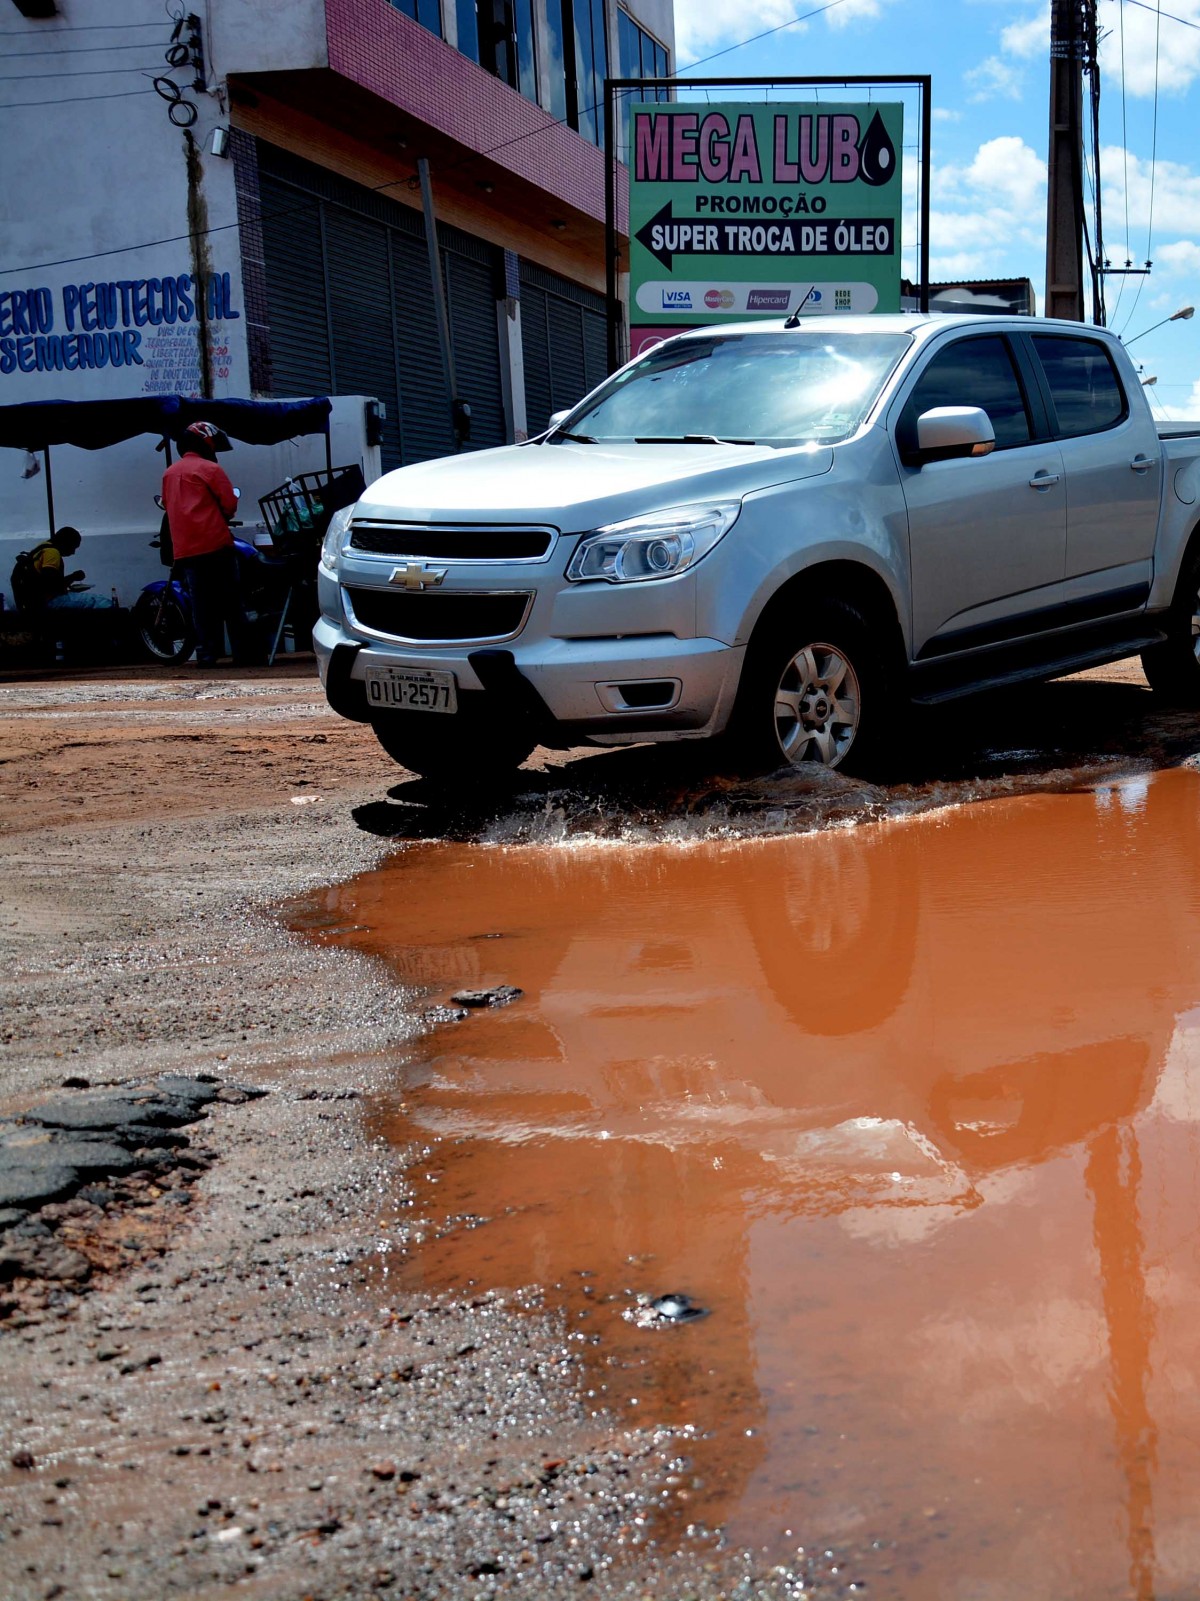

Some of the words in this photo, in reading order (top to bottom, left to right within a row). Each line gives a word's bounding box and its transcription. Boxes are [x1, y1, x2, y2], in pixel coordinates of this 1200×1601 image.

[634, 112, 763, 184] MEGA
[773, 113, 860, 184] LUB
[695, 192, 827, 218] PROMOÇÃO
[651, 224, 719, 251] SUPER
[725, 224, 795, 252] TROCA
[801, 226, 828, 251] DE
[834, 220, 890, 252] ÓLEO
[667, 291, 691, 302] VISA
[749, 294, 788, 305] Hipercard
[0, 330, 144, 374] SEMEADOR
[370, 680, 450, 708] OIU-2577
